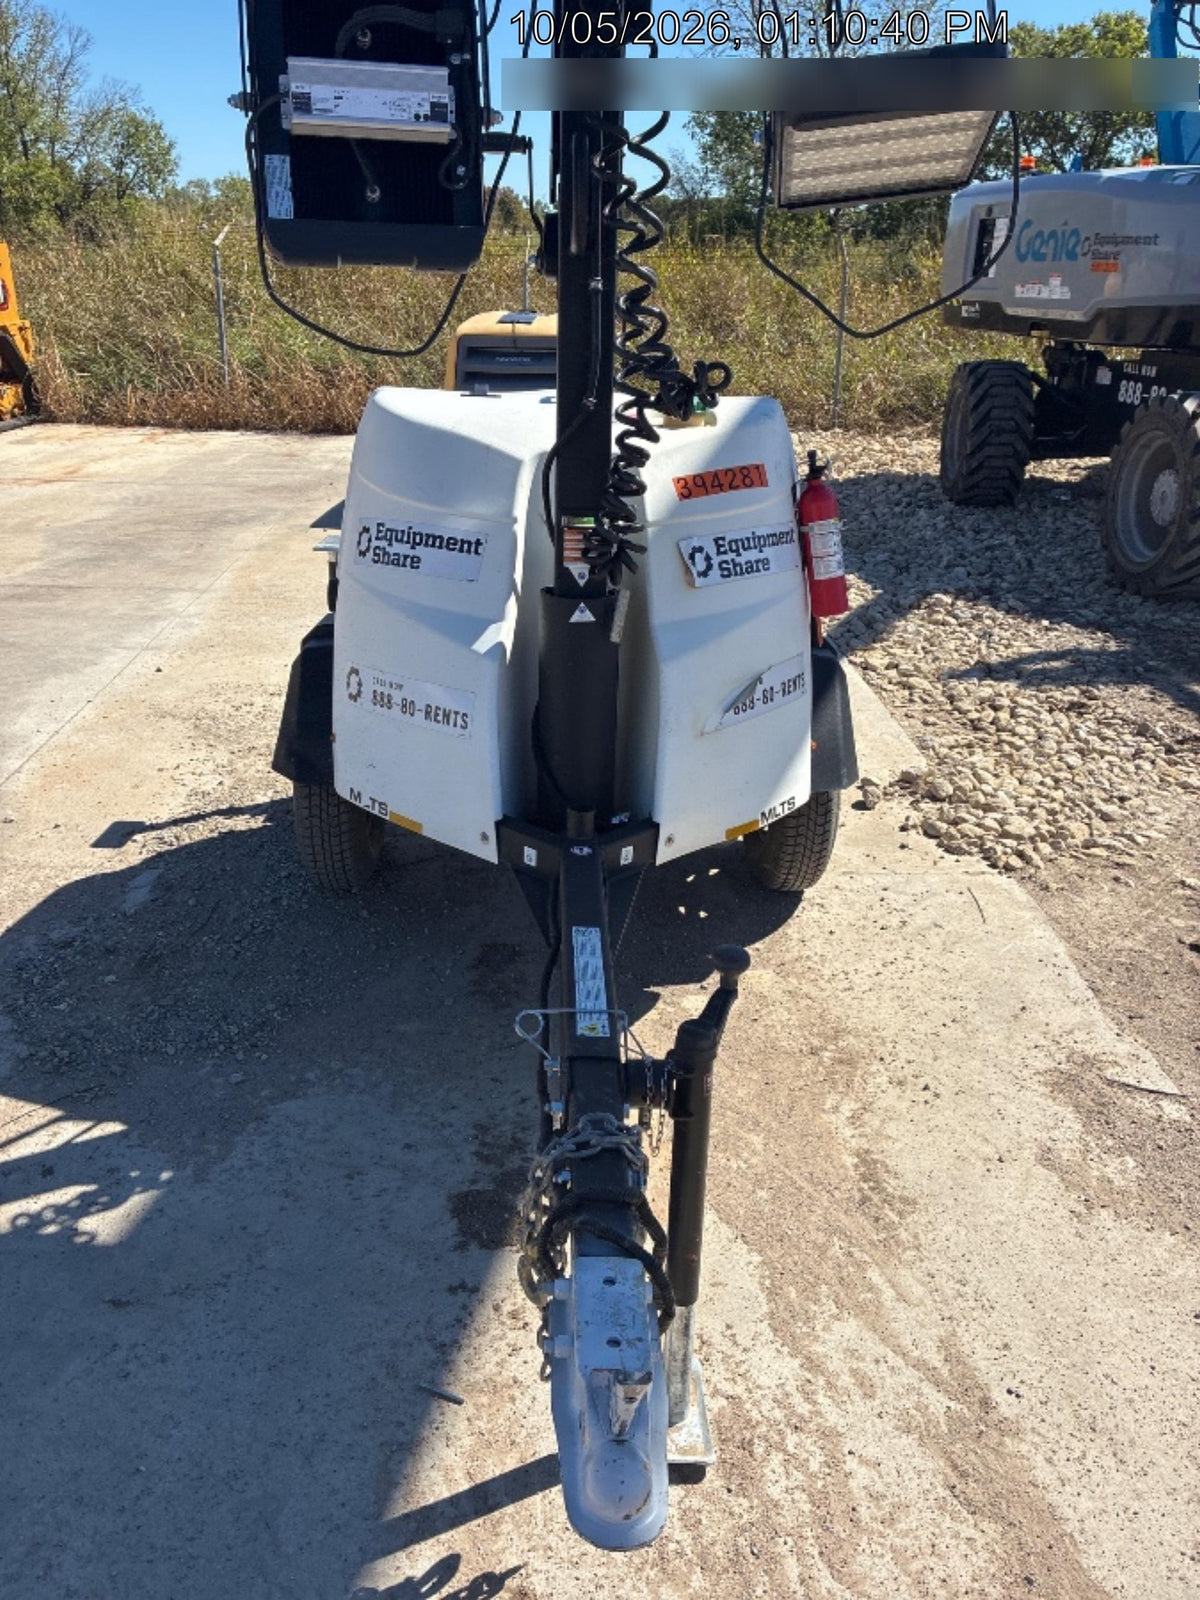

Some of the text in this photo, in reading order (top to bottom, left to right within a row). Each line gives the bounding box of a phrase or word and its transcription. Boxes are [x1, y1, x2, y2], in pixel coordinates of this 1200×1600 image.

[1015, 219, 1082, 263] Genie
[1093, 232, 1160, 248] Equipment
[676, 466, 765, 499] 394281
[374, 522, 485, 556] Equipment
[713, 527, 795, 557] Equipment
[371, 545, 423, 570] Share
[717, 556, 771, 579] Share
[760, 796, 796, 826] MLTS
